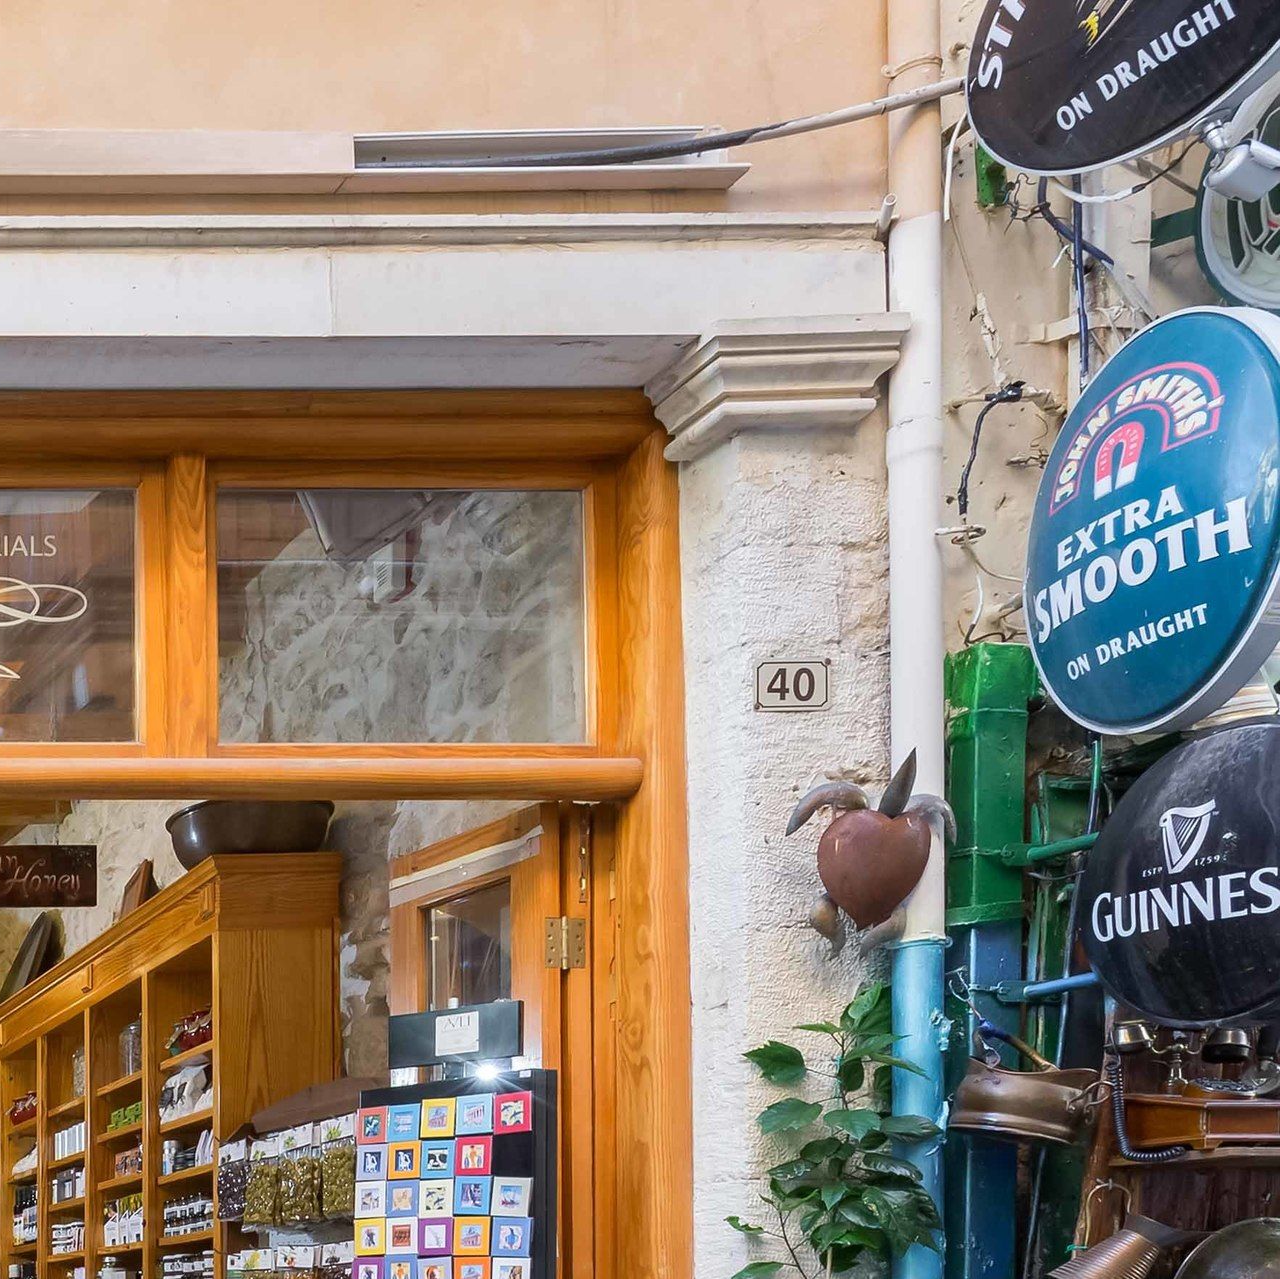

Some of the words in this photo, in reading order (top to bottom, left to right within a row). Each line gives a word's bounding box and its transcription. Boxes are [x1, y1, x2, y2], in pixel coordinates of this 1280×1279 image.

[1056, 92, 1093, 130] ON
[1096, 0, 1238, 101] DRAUGHT
[1054, 404, 1111, 503] JOHN
[1115, 373, 1226, 438] SMITH'S
[1034, 496, 1253, 645] SMOOTH
[1056, 485, 1185, 572] EXTRA
[767, 667, 815, 701] 40
[1067, 650, 1091, 681] ON
[1096, 603, 1209, 666] DRAUGHT
[3, 858, 82, 899] Honey
